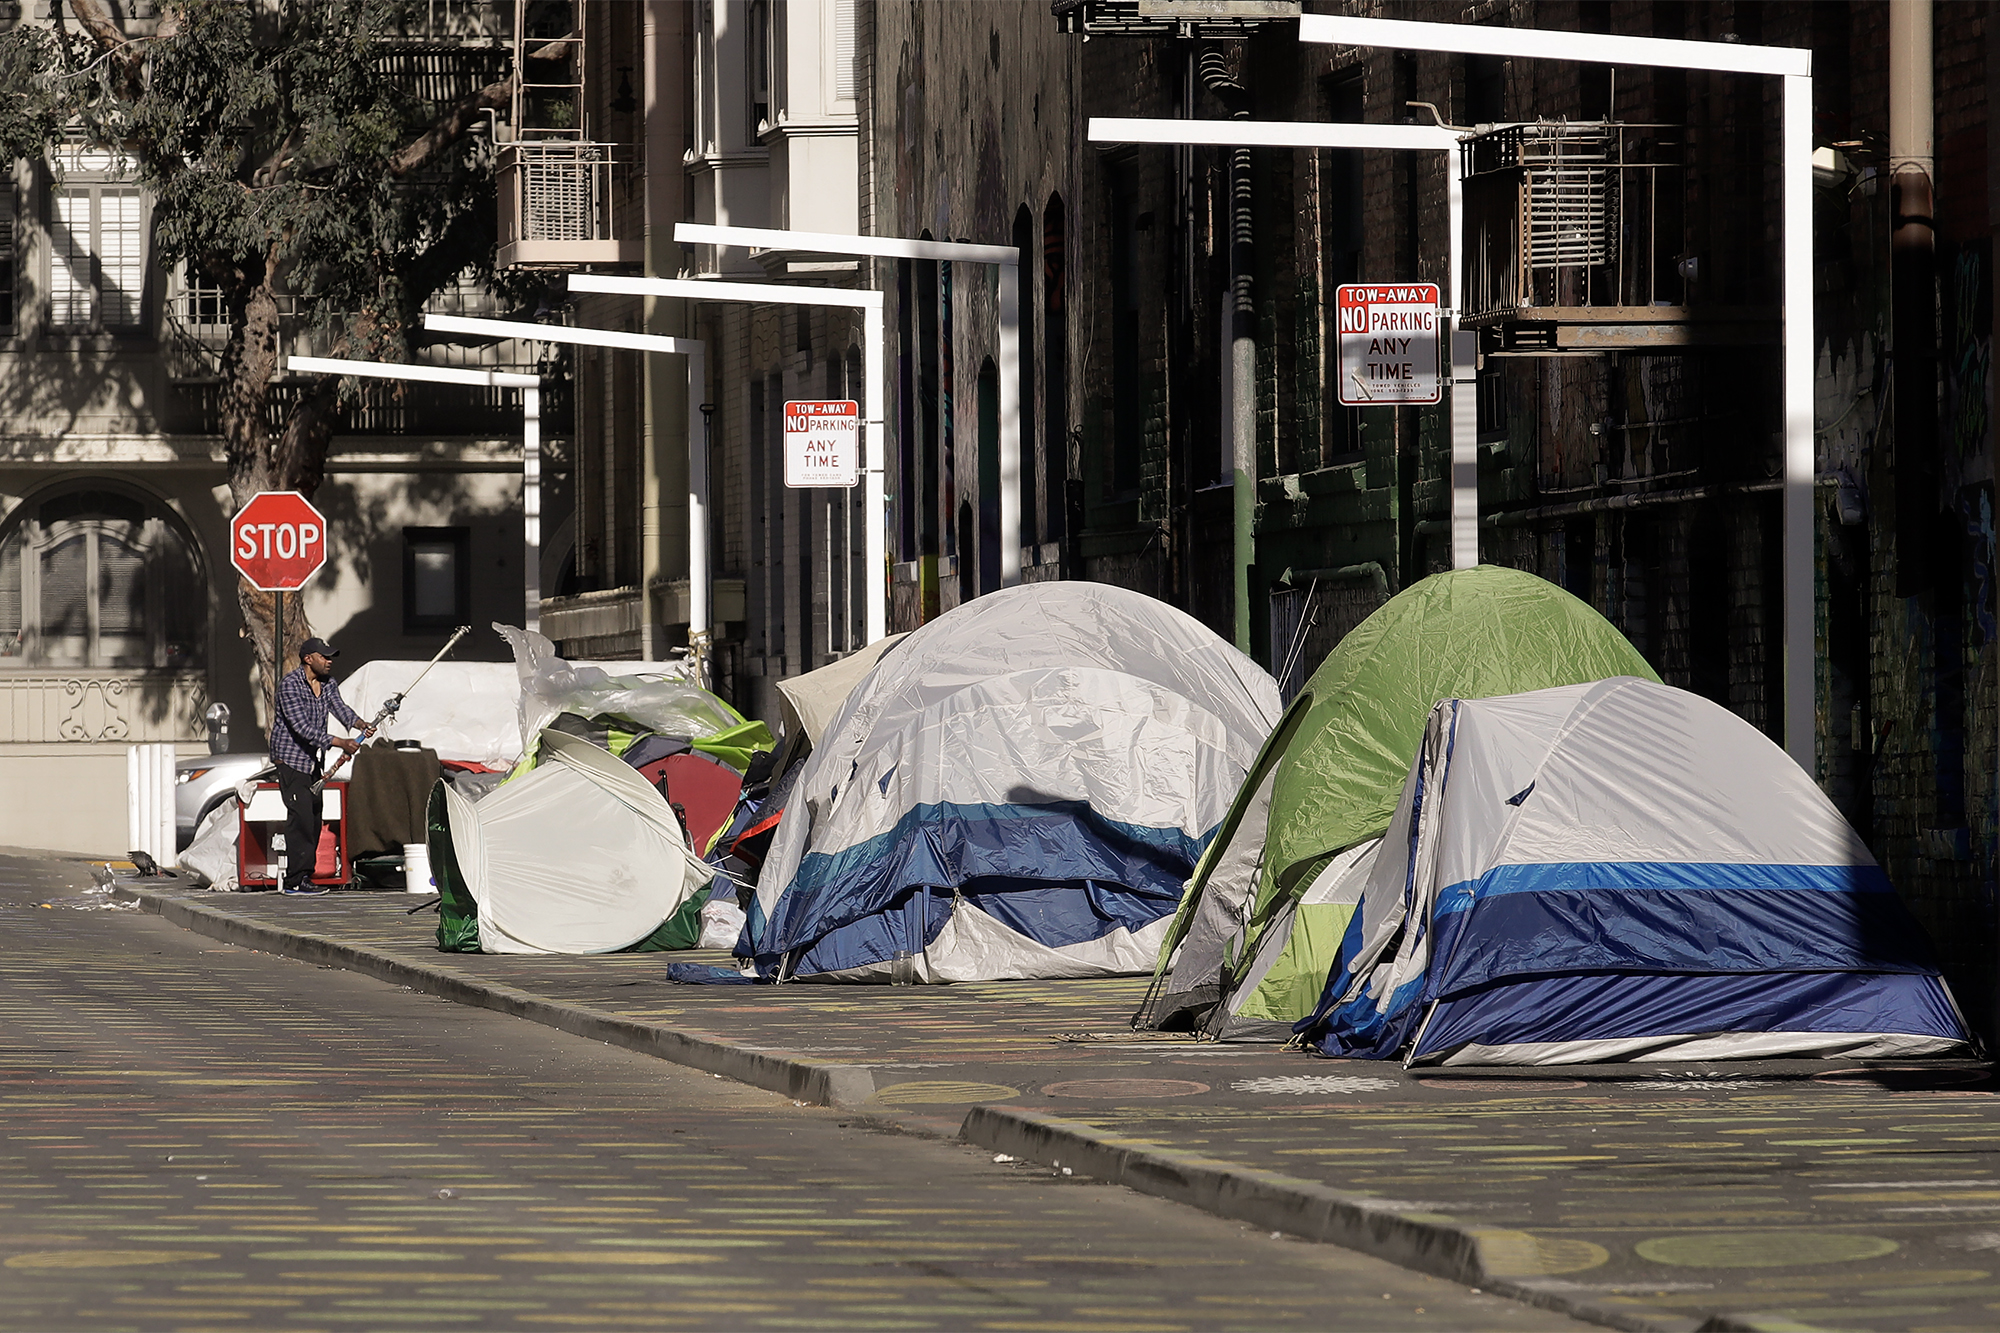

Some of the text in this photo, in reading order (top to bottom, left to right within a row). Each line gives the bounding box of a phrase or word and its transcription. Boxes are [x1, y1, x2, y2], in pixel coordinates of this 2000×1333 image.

[1346, 288, 1429, 302] TOW-AWAY
[1341, 306, 1432, 331] NO PARKING
[1368, 338, 1411, 354] ANY
[1367, 363, 1413, 379] TIME
[795, 403, 847, 414] TOW-AWAY
[787, 415, 854, 431] NO PARKING
[806, 440, 837, 452] ANY
[804, 455, 839, 467] TIME
[238, 523, 319, 560] STOP
